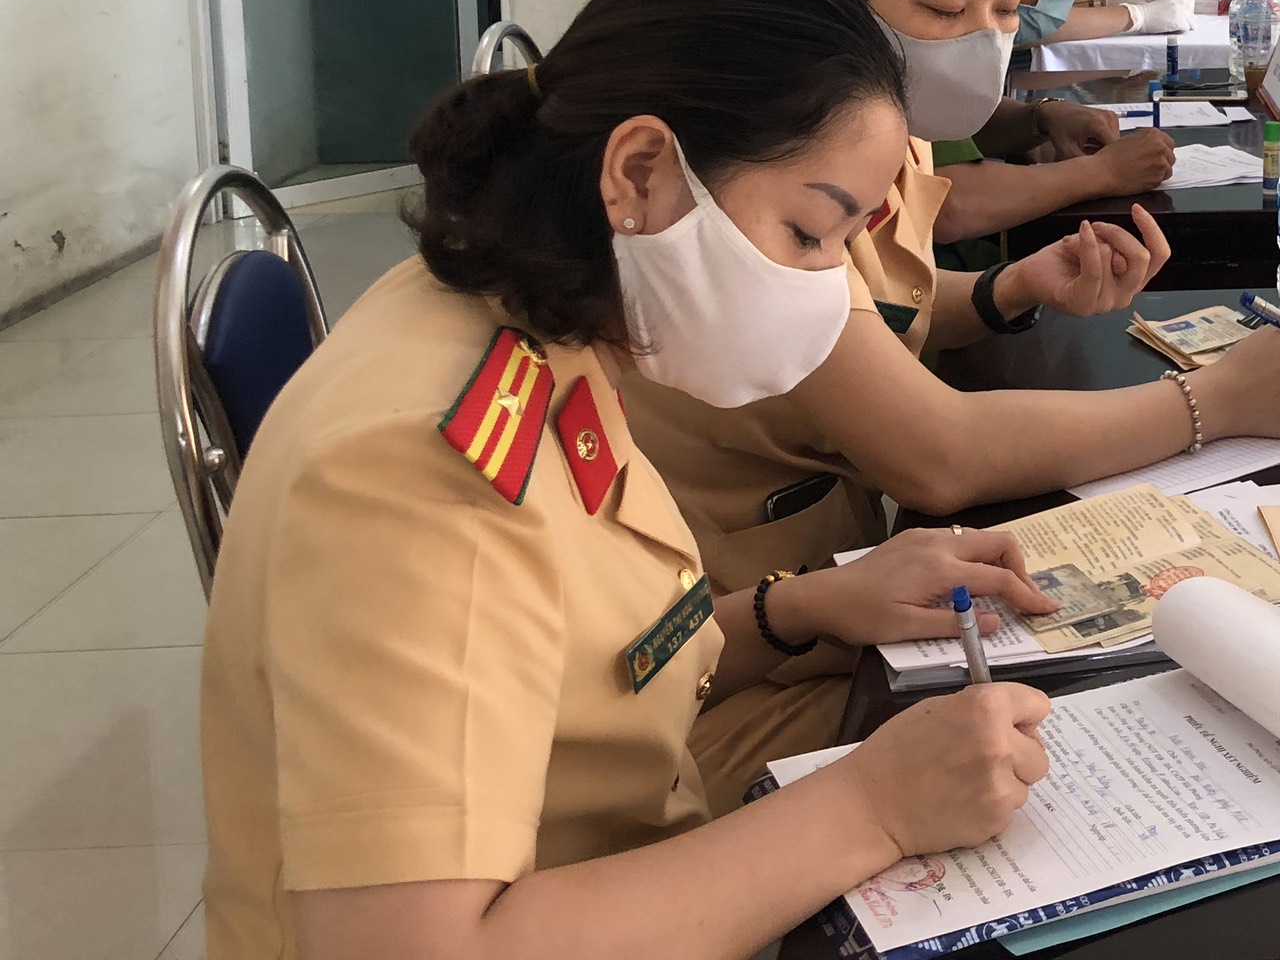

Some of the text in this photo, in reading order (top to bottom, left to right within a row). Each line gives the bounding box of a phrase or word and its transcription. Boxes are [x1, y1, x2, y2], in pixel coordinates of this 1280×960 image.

[667, 609, 704, 653] 137 431
[1183, 715, 1202, 729] PHIẾU
[1209, 737, 1226, 752] NGHỊ
[1222, 751, 1238, 762] XÉT
[1236, 762, 1261, 783] NGHIỆM
